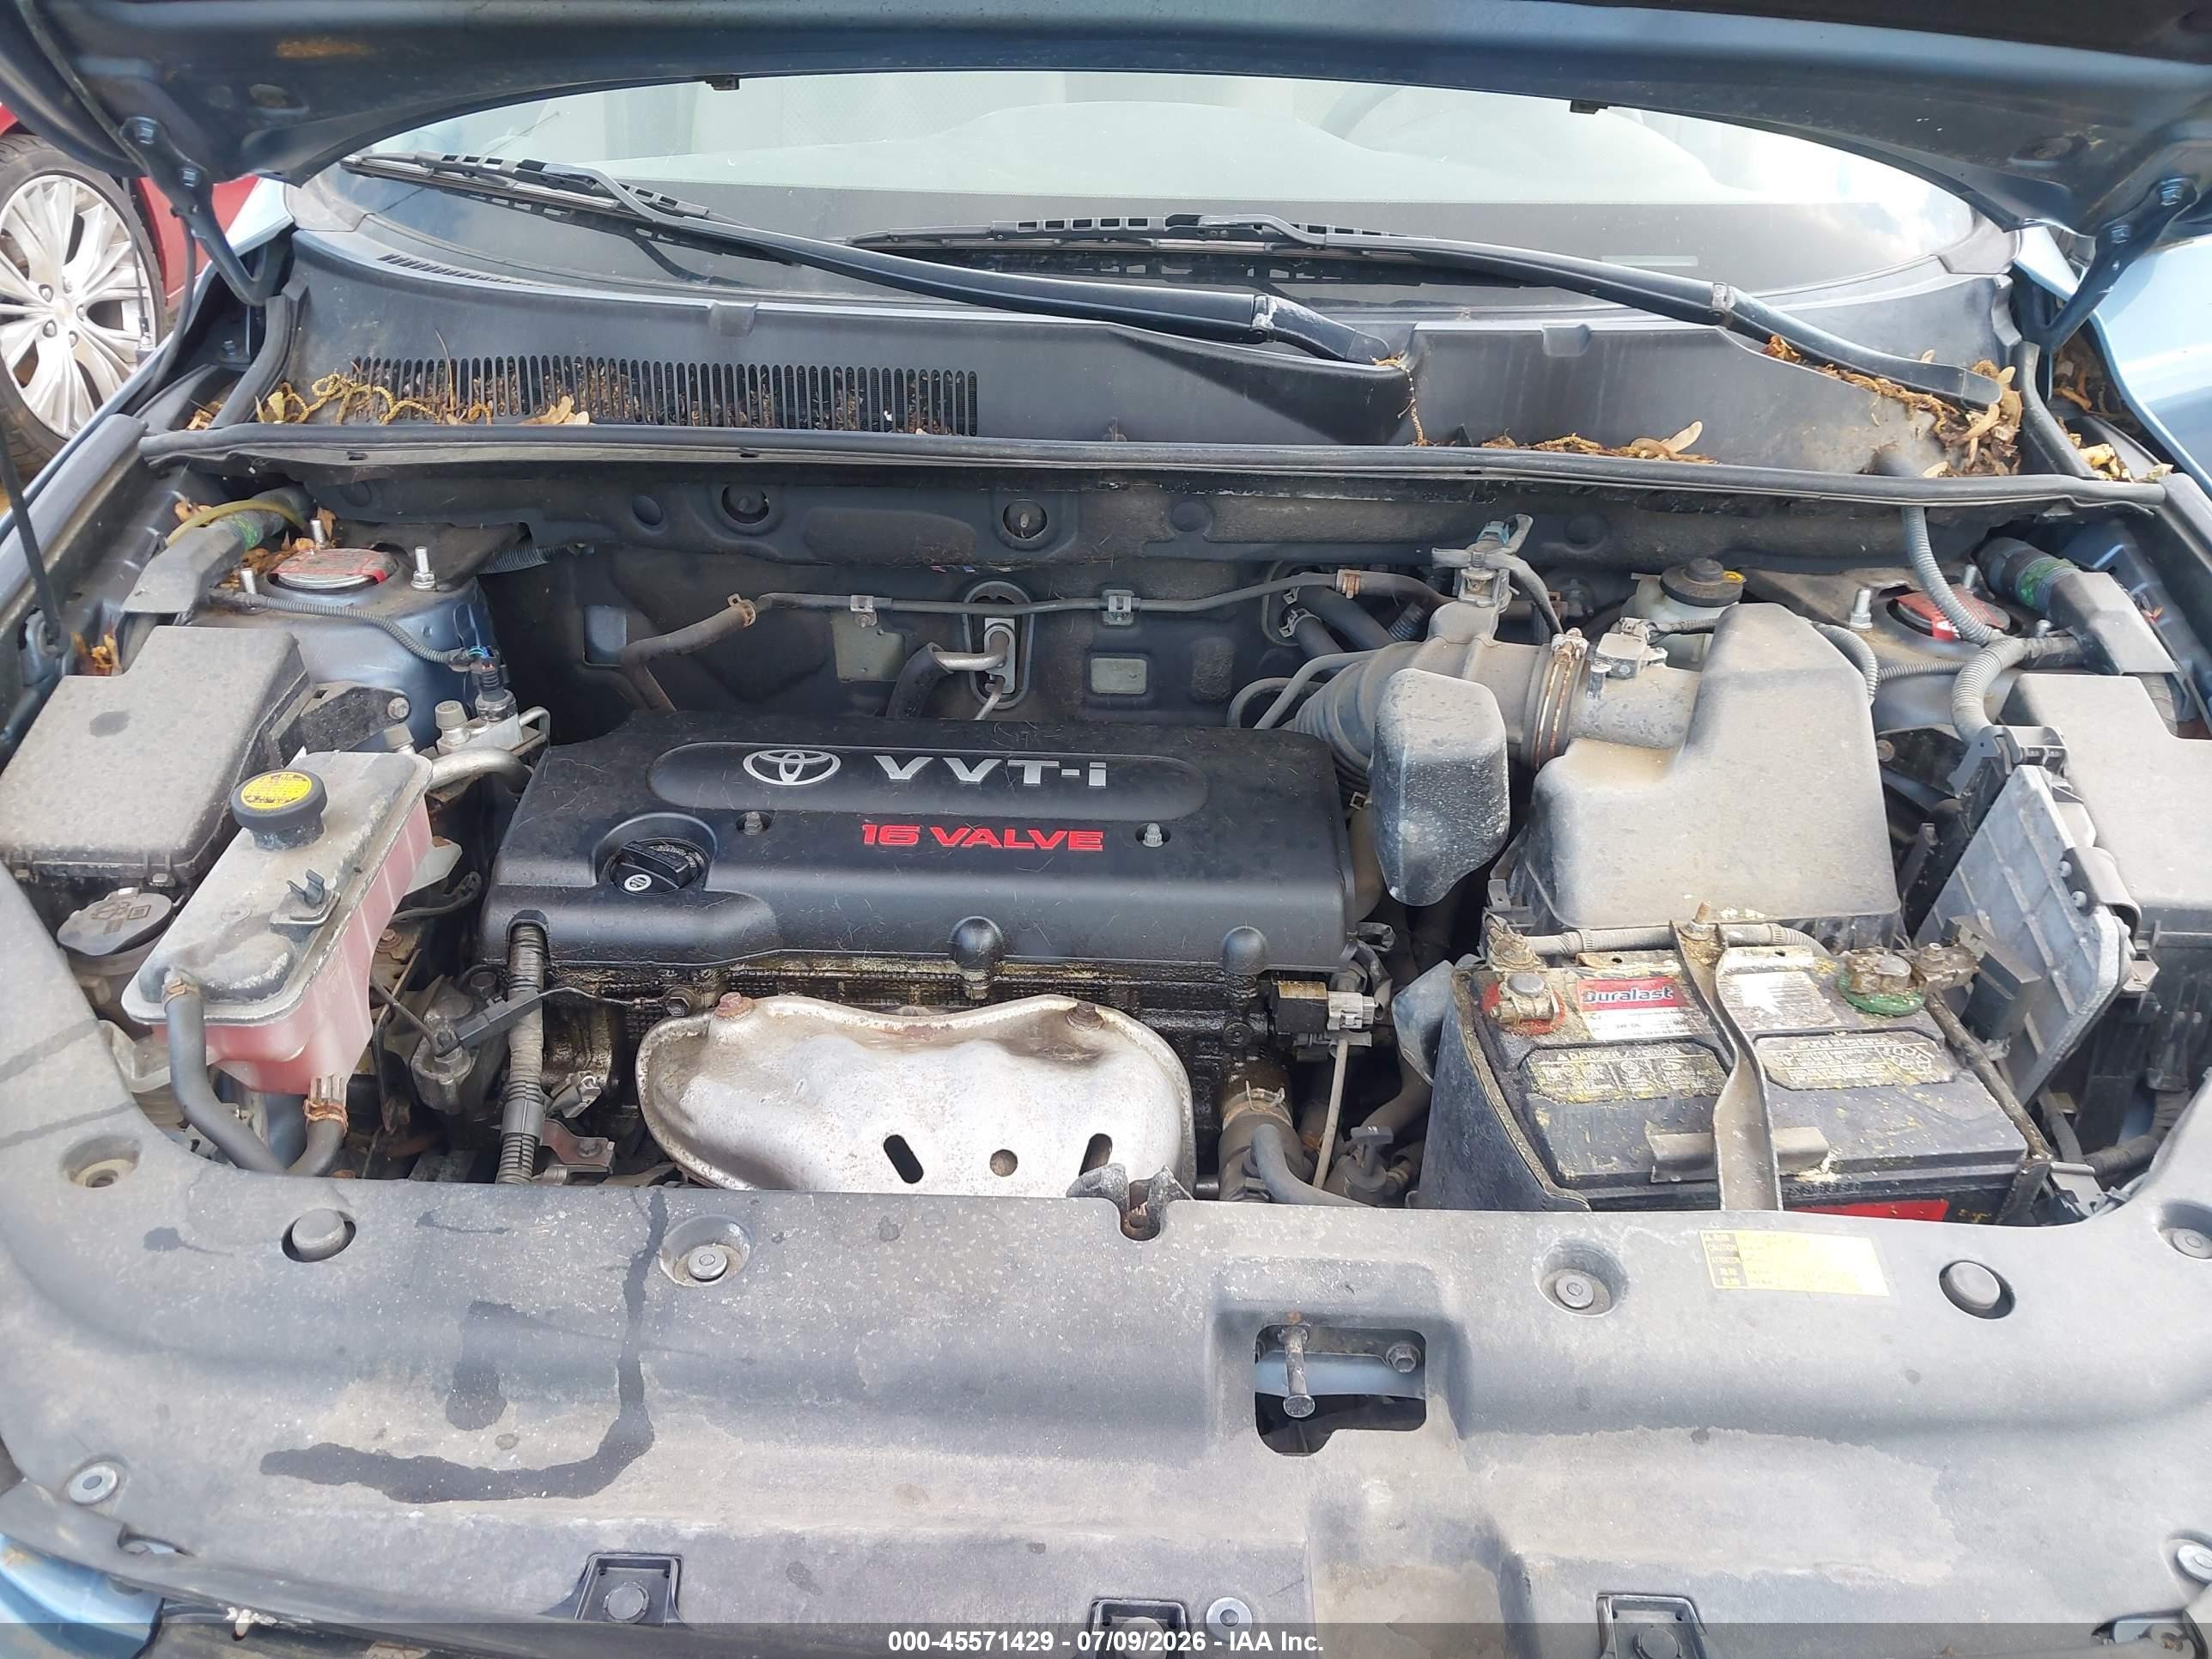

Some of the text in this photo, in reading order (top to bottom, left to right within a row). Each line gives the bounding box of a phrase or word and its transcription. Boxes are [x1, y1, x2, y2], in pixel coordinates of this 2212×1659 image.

[874, 755, 1106, 787] VVT-i
[861, 823, 1104, 851] 16 VALVE
[1583, 986, 1674, 1004] Duralast
